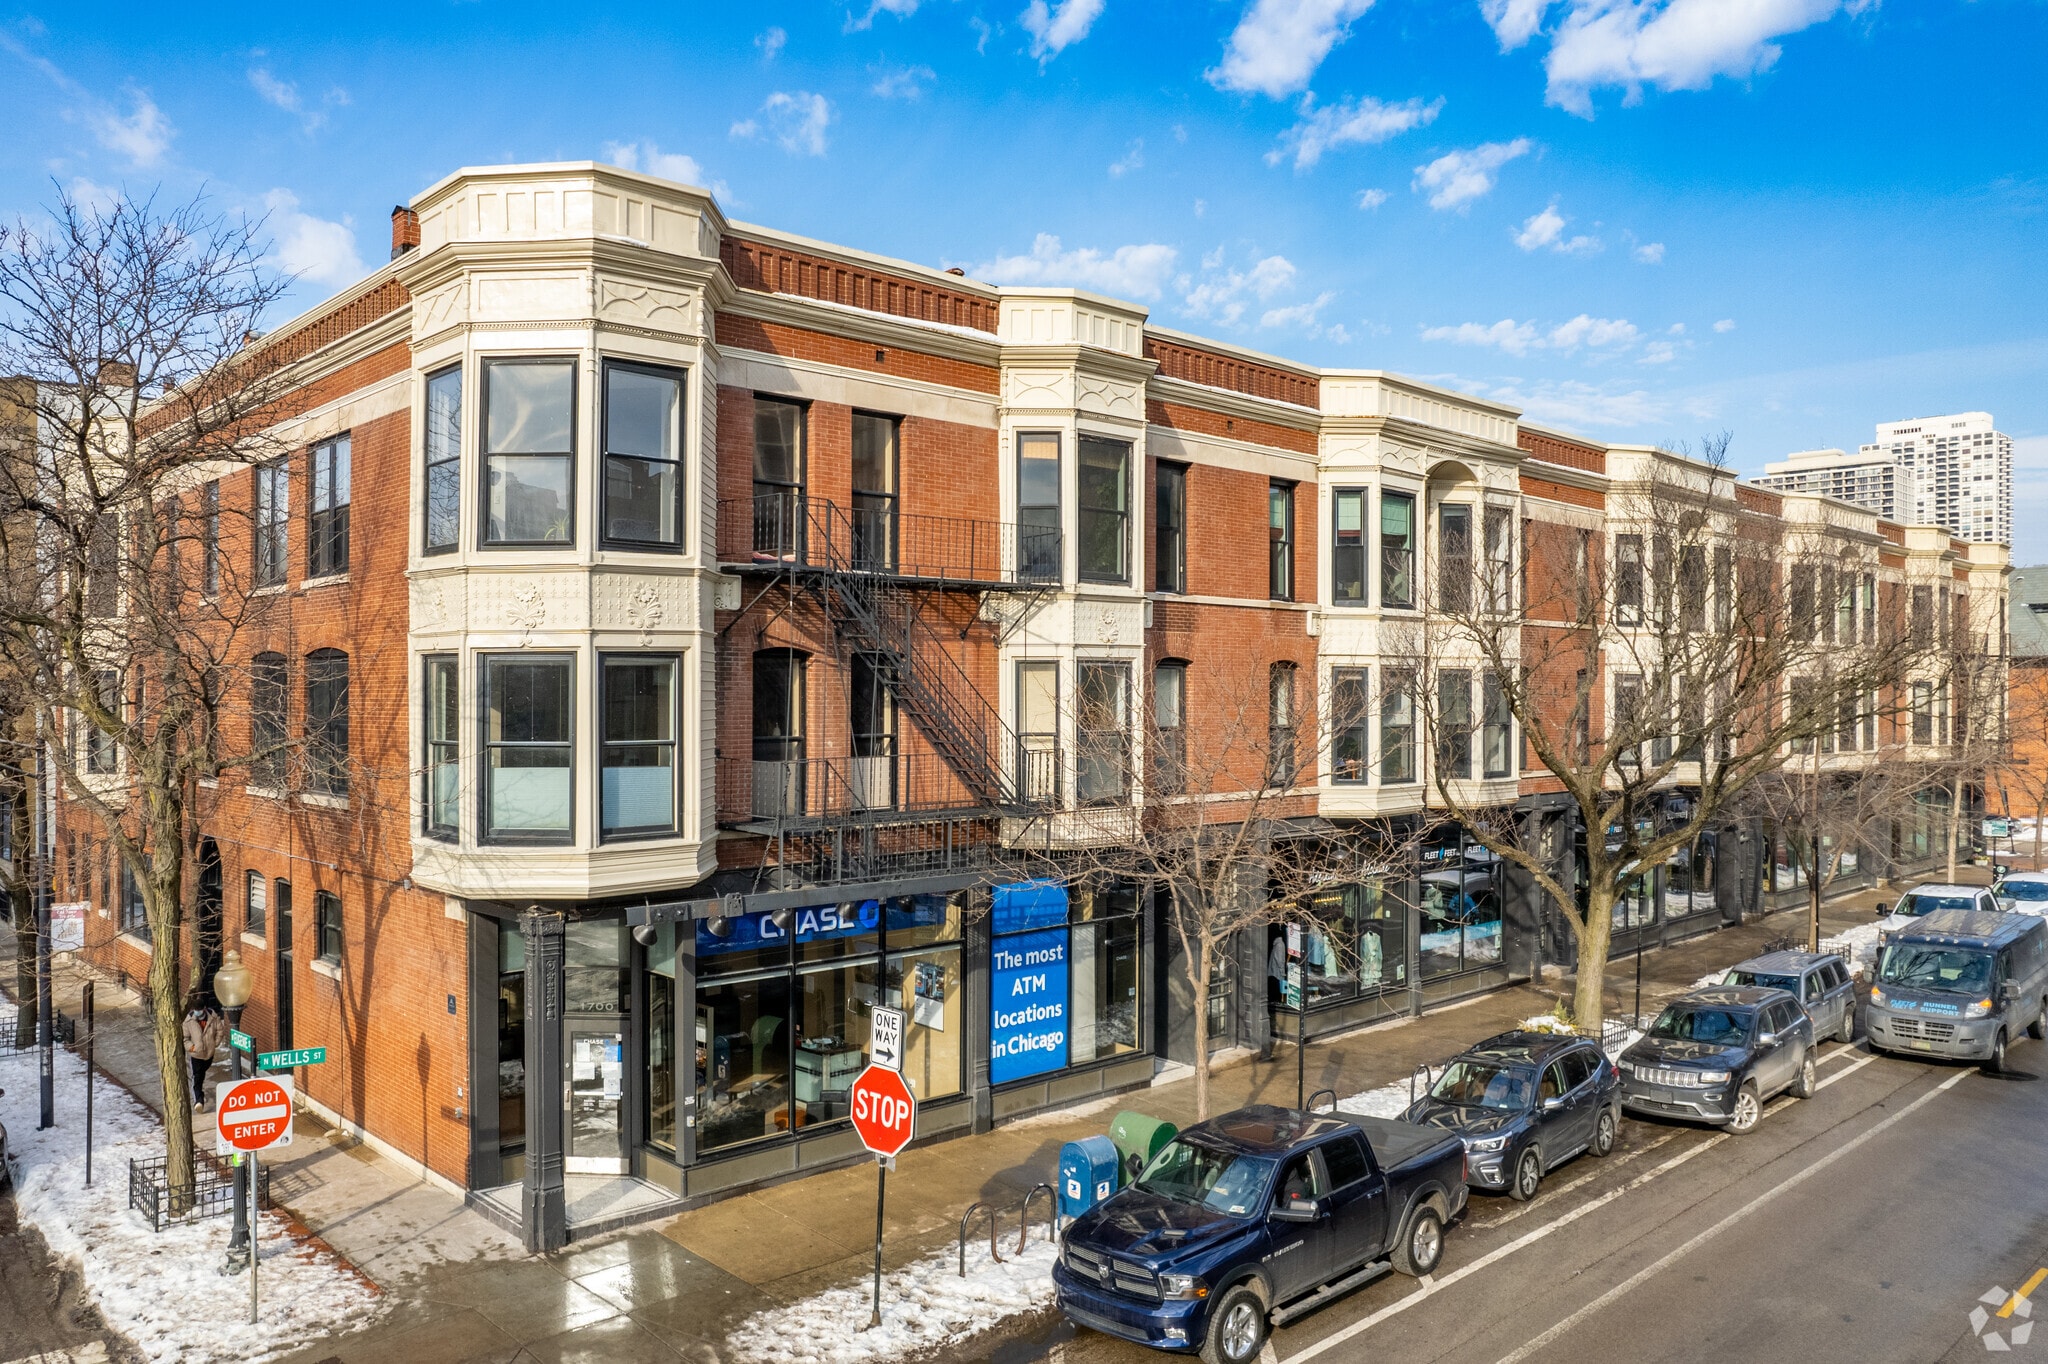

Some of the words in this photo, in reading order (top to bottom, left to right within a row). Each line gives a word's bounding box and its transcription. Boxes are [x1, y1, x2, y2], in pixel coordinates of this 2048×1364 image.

[1424, 851, 1439, 860] FLEET
[1444, 848, 1457, 857] FEET
[1467, 845, 1482, 854] FLEET
[994, 950, 1022, 970] The
[1025, 944, 1063, 965] most
[1011, 973, 1046, 997] ATM
[581, 1002, 614, 1011] 1700
[1920, 1007, 1960, 1016] SUPPORT
[1923, 1002, 1958, 1011] RUNNER
[875, 1013, 898, 1031] ONE
[994, 1003, 1062, 1029] locations
[875, 1028, 898, 1046] WAY
[991, 1040, 1006, 1059] in
[1008, 1031, 1064, 1054] Chicago
[263, 1058, 269, 1066] N
[271, 1051, 310, 1067] WELLS
[313, 1052, 322, 1060] ST
[228, 1095, 247, 1108] DO
[254, 1091, 280, 1105] NOT
[855, 1087, 909, 1131] STOP
[234, 1122, 276, 1139] ENTER
